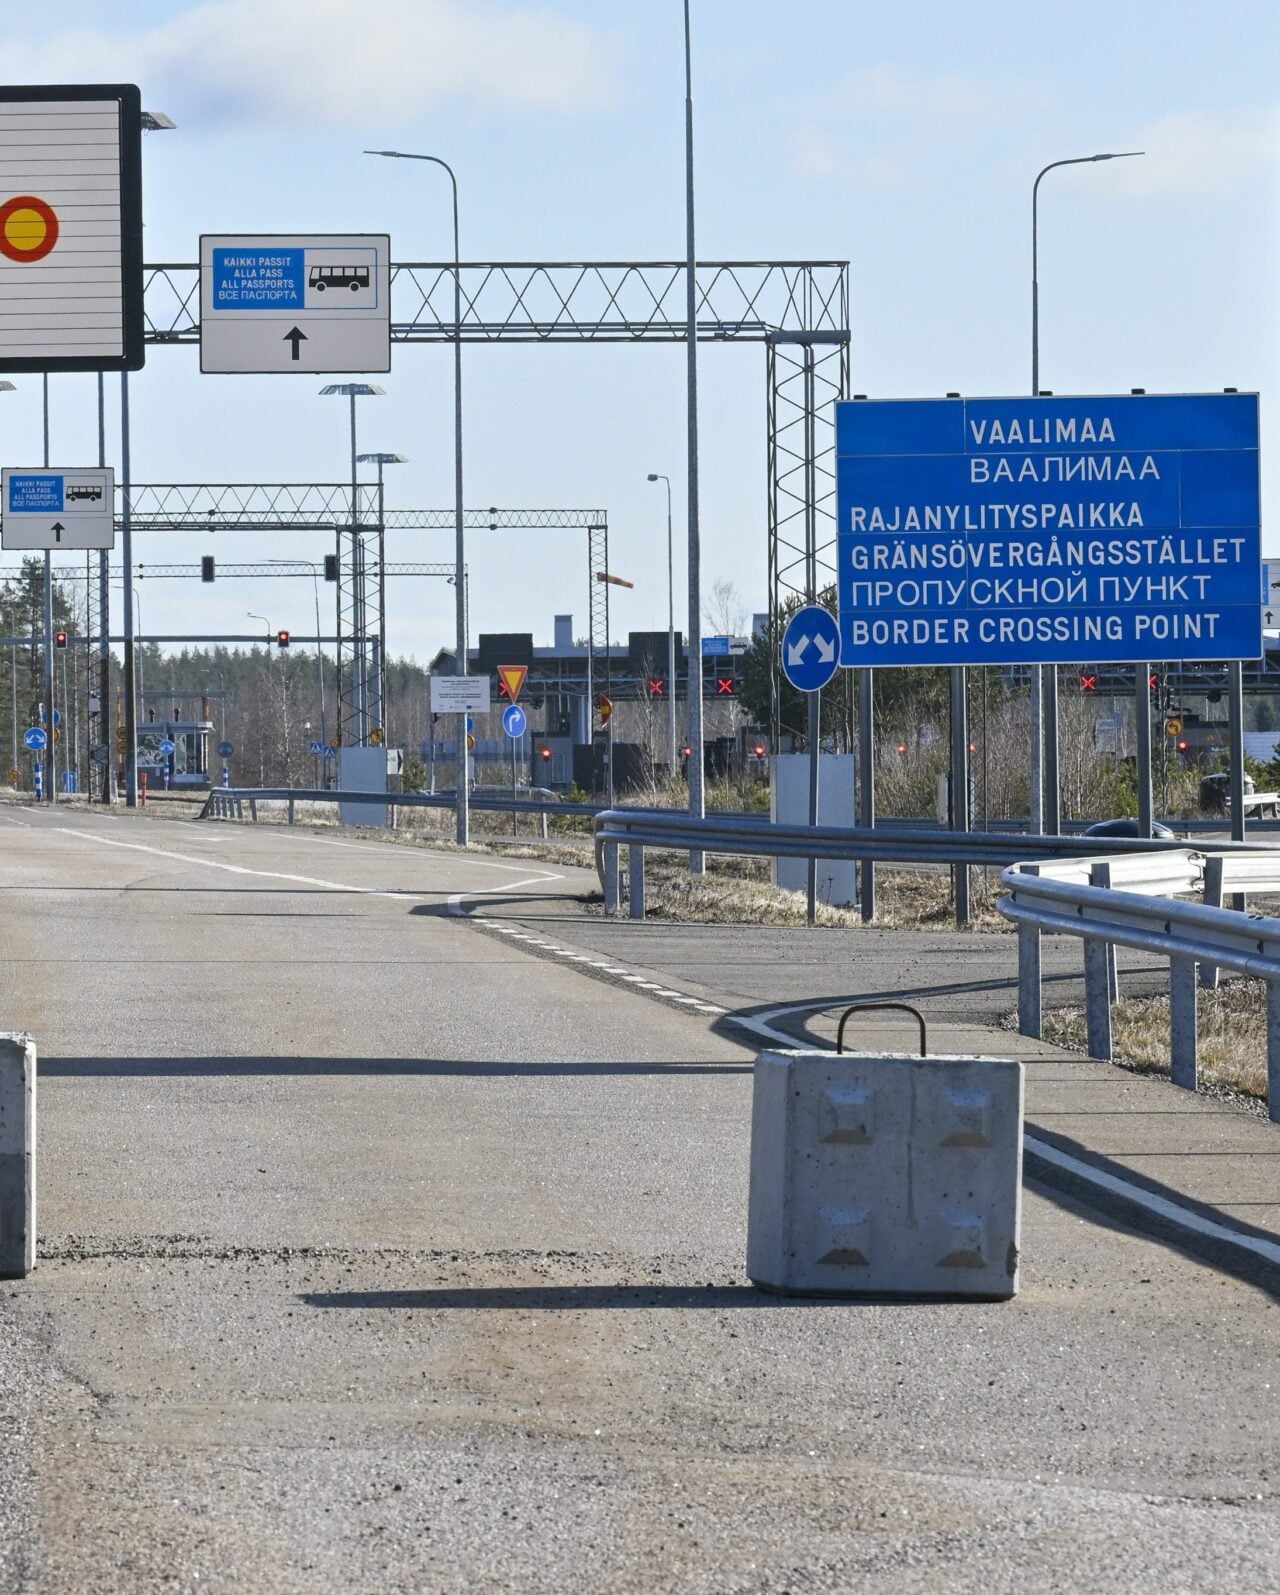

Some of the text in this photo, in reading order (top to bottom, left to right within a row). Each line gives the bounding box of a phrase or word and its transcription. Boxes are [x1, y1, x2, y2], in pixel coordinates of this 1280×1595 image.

[224, 257, 291, 267] KAIKKI PASSIT
[234, 268, 283, 278] ALLA PASS
[219, 290, 297, 300] ВСЕ ПАСПОРТА
[221, 279, 294, 289] ALL PASSPORTS
[970, 417, 1116, 444] VAALIMAA
[970, 455, 1160, 483] ВААЛИМАА
[850, 502, 1144, 532] RAJANYLITYSPAIKKA
[851, 535, 1246, 570] GRÄNSÖVERGÅNGSSTÄLLET
[852, 570, 1212, 606] ПРОПУСКНОЙ ПУНКТ
[853, 613, 1220, 645] BORDER CROSSING POINT
